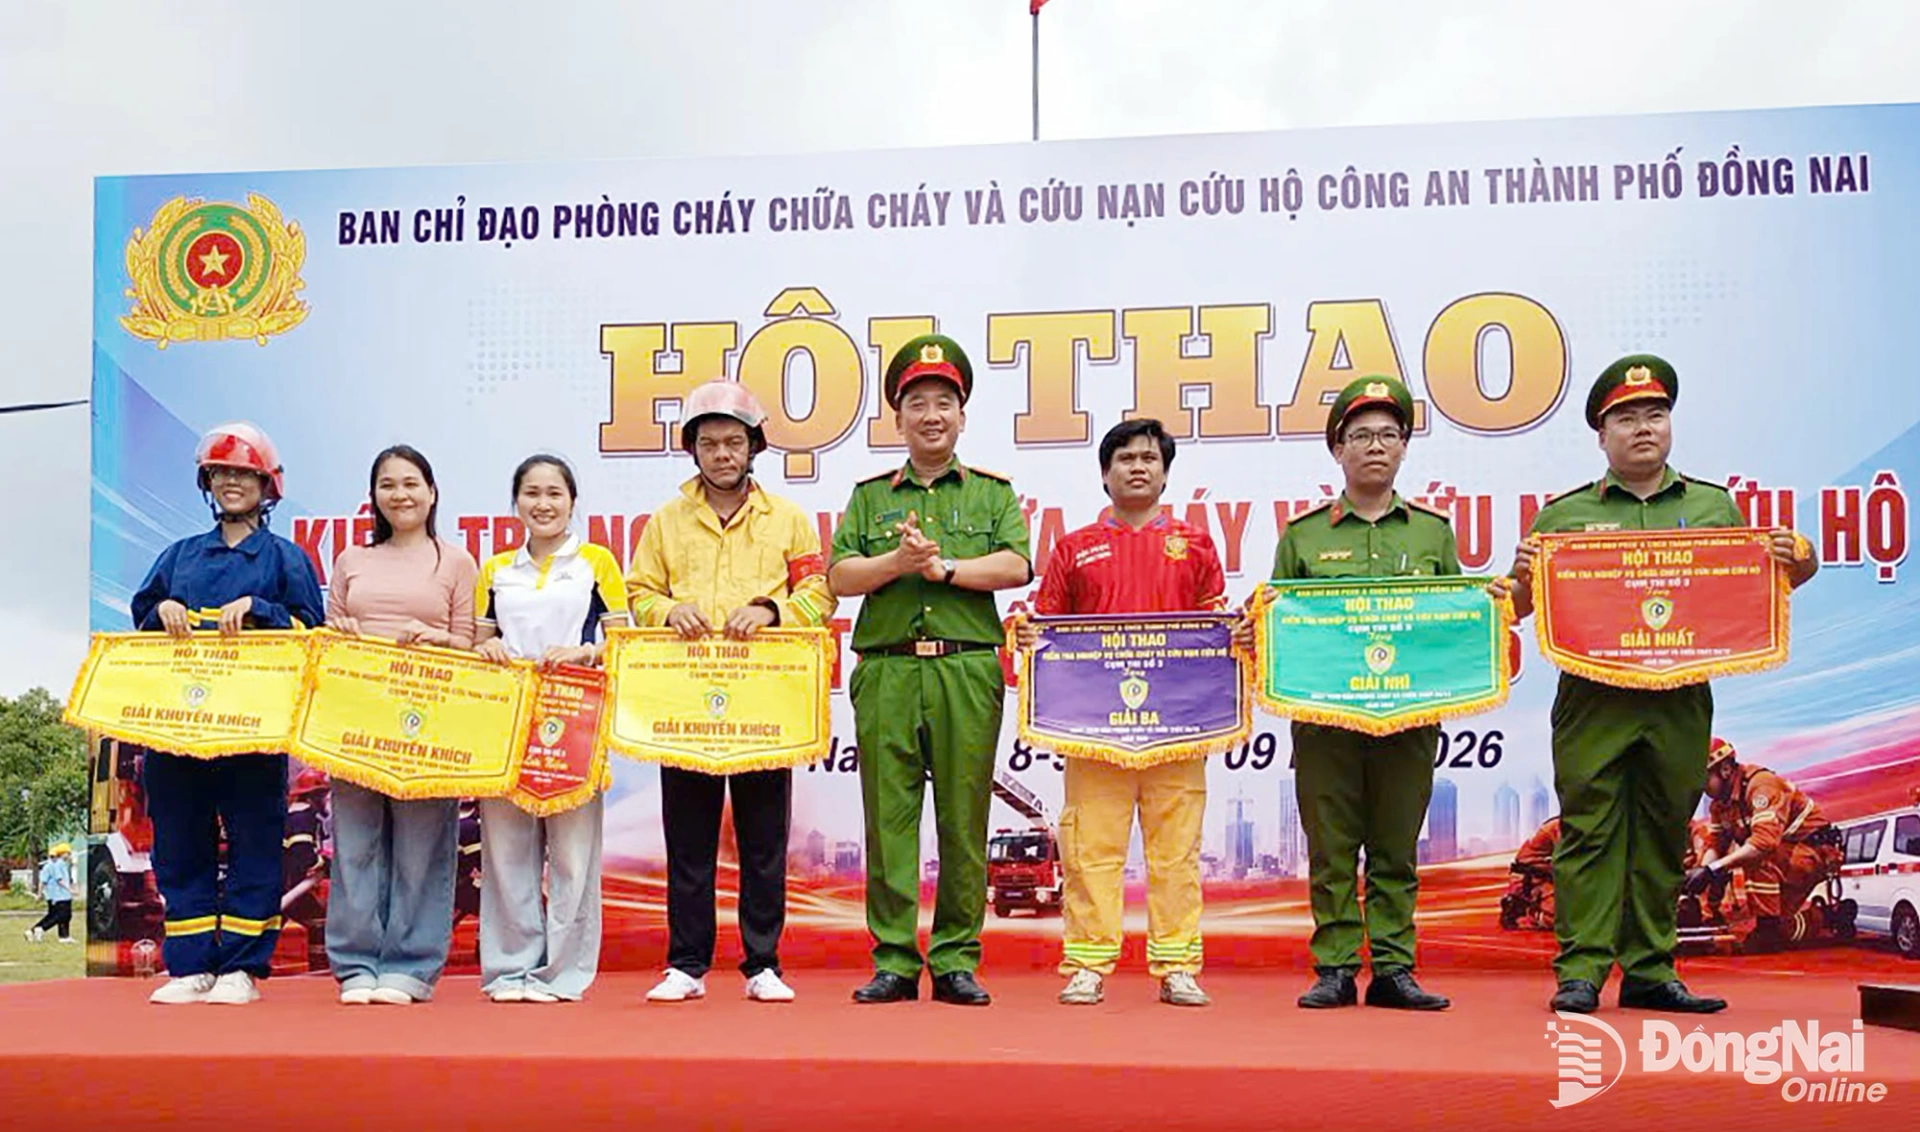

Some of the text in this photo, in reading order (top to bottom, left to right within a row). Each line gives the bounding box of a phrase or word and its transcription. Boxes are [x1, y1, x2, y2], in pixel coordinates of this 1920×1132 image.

[338, 145, 1869, 248] BAN CHỈ ĐẠO PHÒNG CHÁY CHỮA CHÁY VÀ CỨU NẠN CỨU HỘ CÔNG AN THÀNH PHỐ ĐỒNG NAI
[599, 287, 1567, 478] HỘI THAO
[1822, 473, 1906, 578] HỘ
[1623, 549, 1692, 567] HỘI THAO
[1345, 597, 1413, 612] HỘI THAO
[1101, 631, 1166, 649] HỘI THAO
[1621, 626, 1694, 647] GIẢI NHẤT
[174, 646, 239, 660] HỘI THAO
[687, 645, 749, 660] HỘI THAO
[390, 660, 413, 677] HỘI
[419, 664, 453, 682] THAO
[1350, 671, 1411, 690] GIẢI NHÌ
[554, 682, 584, 700] THAO
[122, 703, 152, 719] GIẢI
[155, 708, 213, 724] KHUYẾN
[217, 713, 262, 728] KHÍCH
[1110, 707, 1159, 725] GIẢI BA
[653, 716, 780, 737] GIẢI KHUYẾN KHÍCH
[342, 729, 370, 748] GIẢI
[374, 736, 427, 757] KHUYẾN
[431, 745, 471, 765] KHÍCH
